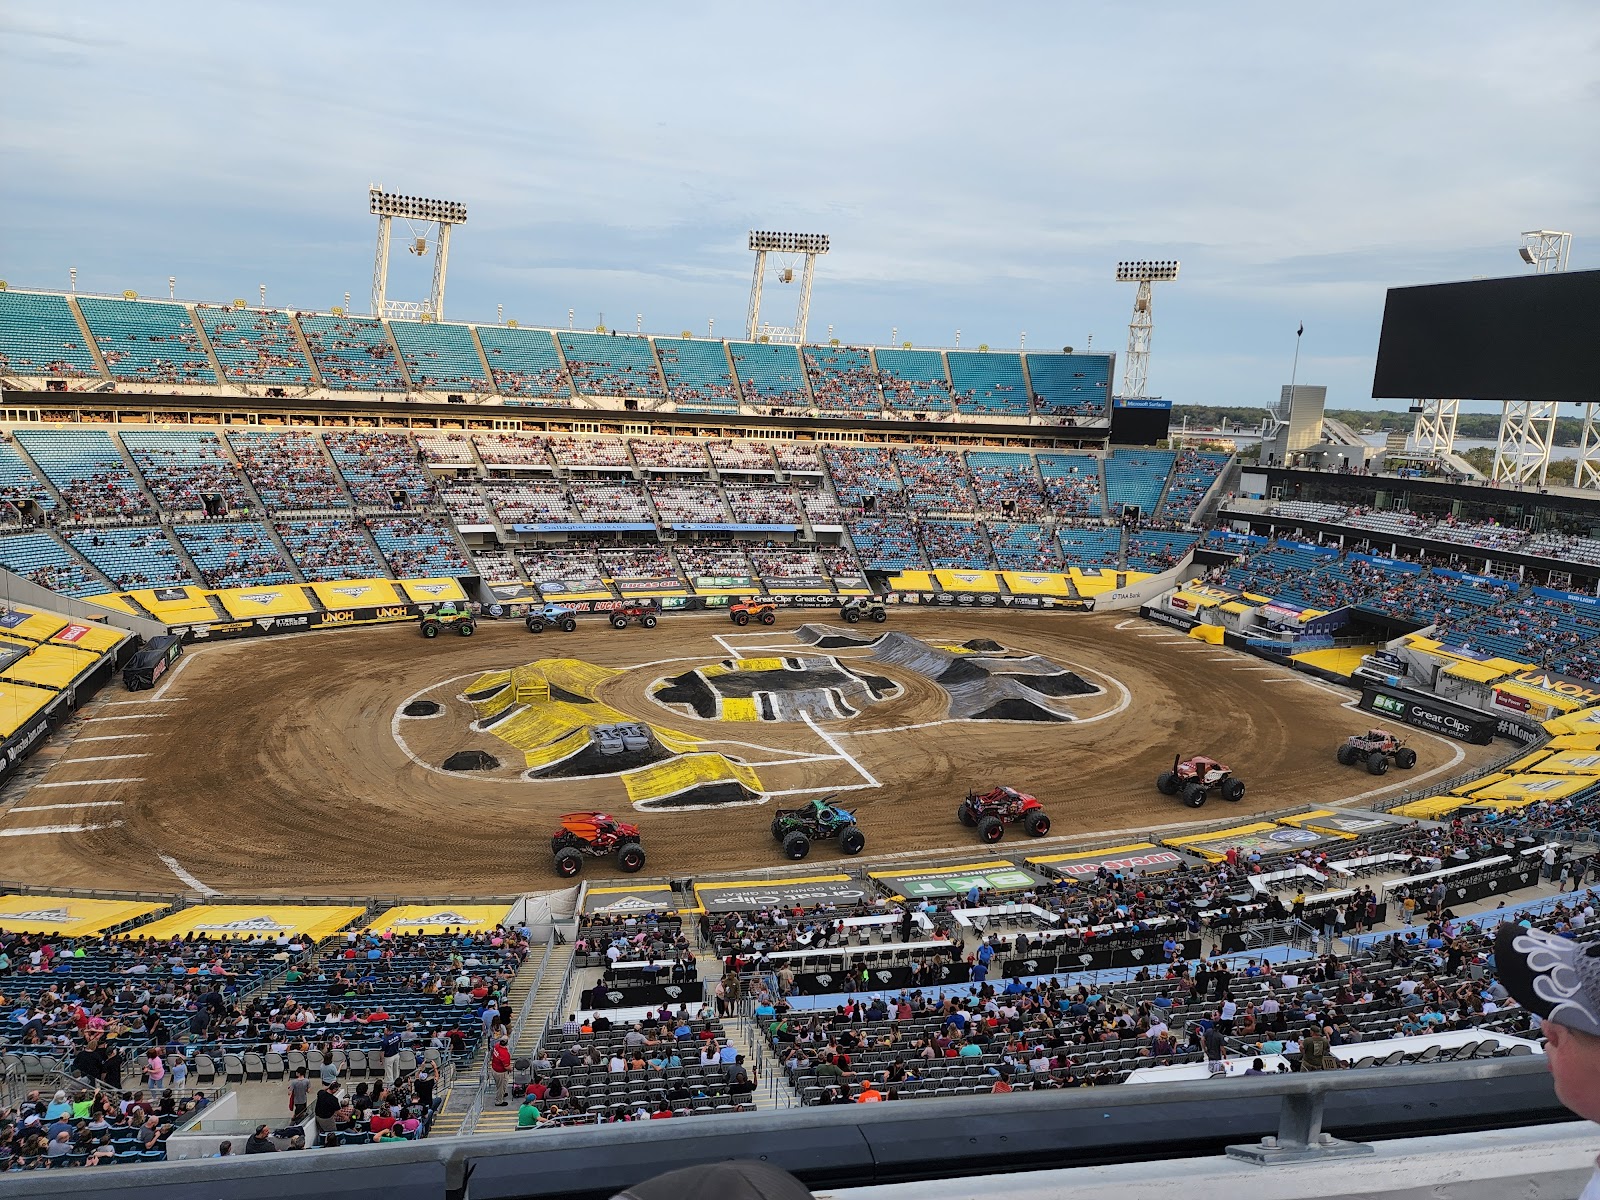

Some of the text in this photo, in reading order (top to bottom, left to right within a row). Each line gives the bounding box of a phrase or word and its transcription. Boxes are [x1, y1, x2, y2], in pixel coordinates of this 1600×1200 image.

[697, 577, 750, 585] BKT
[1188, 584, 1239, 600] UNOH
[594, 600, 622, 610] LUCAS
[662, 597, 686, 606] BKT
[774, 595, 792, 603] Clips
[816, 595, 834, 603] Clips
[1580, 596, 1597, 605] LIGHT
[321, 611, 354, 623] UNOH
[376, 606, 408, 618] UNOH
[1149, 608, 1191, 629] MonsterJam.com
[1375, 696, 1405, 711] BKT
[1411, 706, 1470, 732] Great Clips
[1422, 721, 1440, 731] GONNA
[1448, 729, 1466, 738] GREAT
[1056, 851, 1182, 875] LUCAS OIL
[897, 866, 1016, 882] GROWING TOGETHER
[783, 886, 825, 895] GONNA
[913, 873, 1031, 895] BKT
[713, 890, 865, 905] Great Clips
